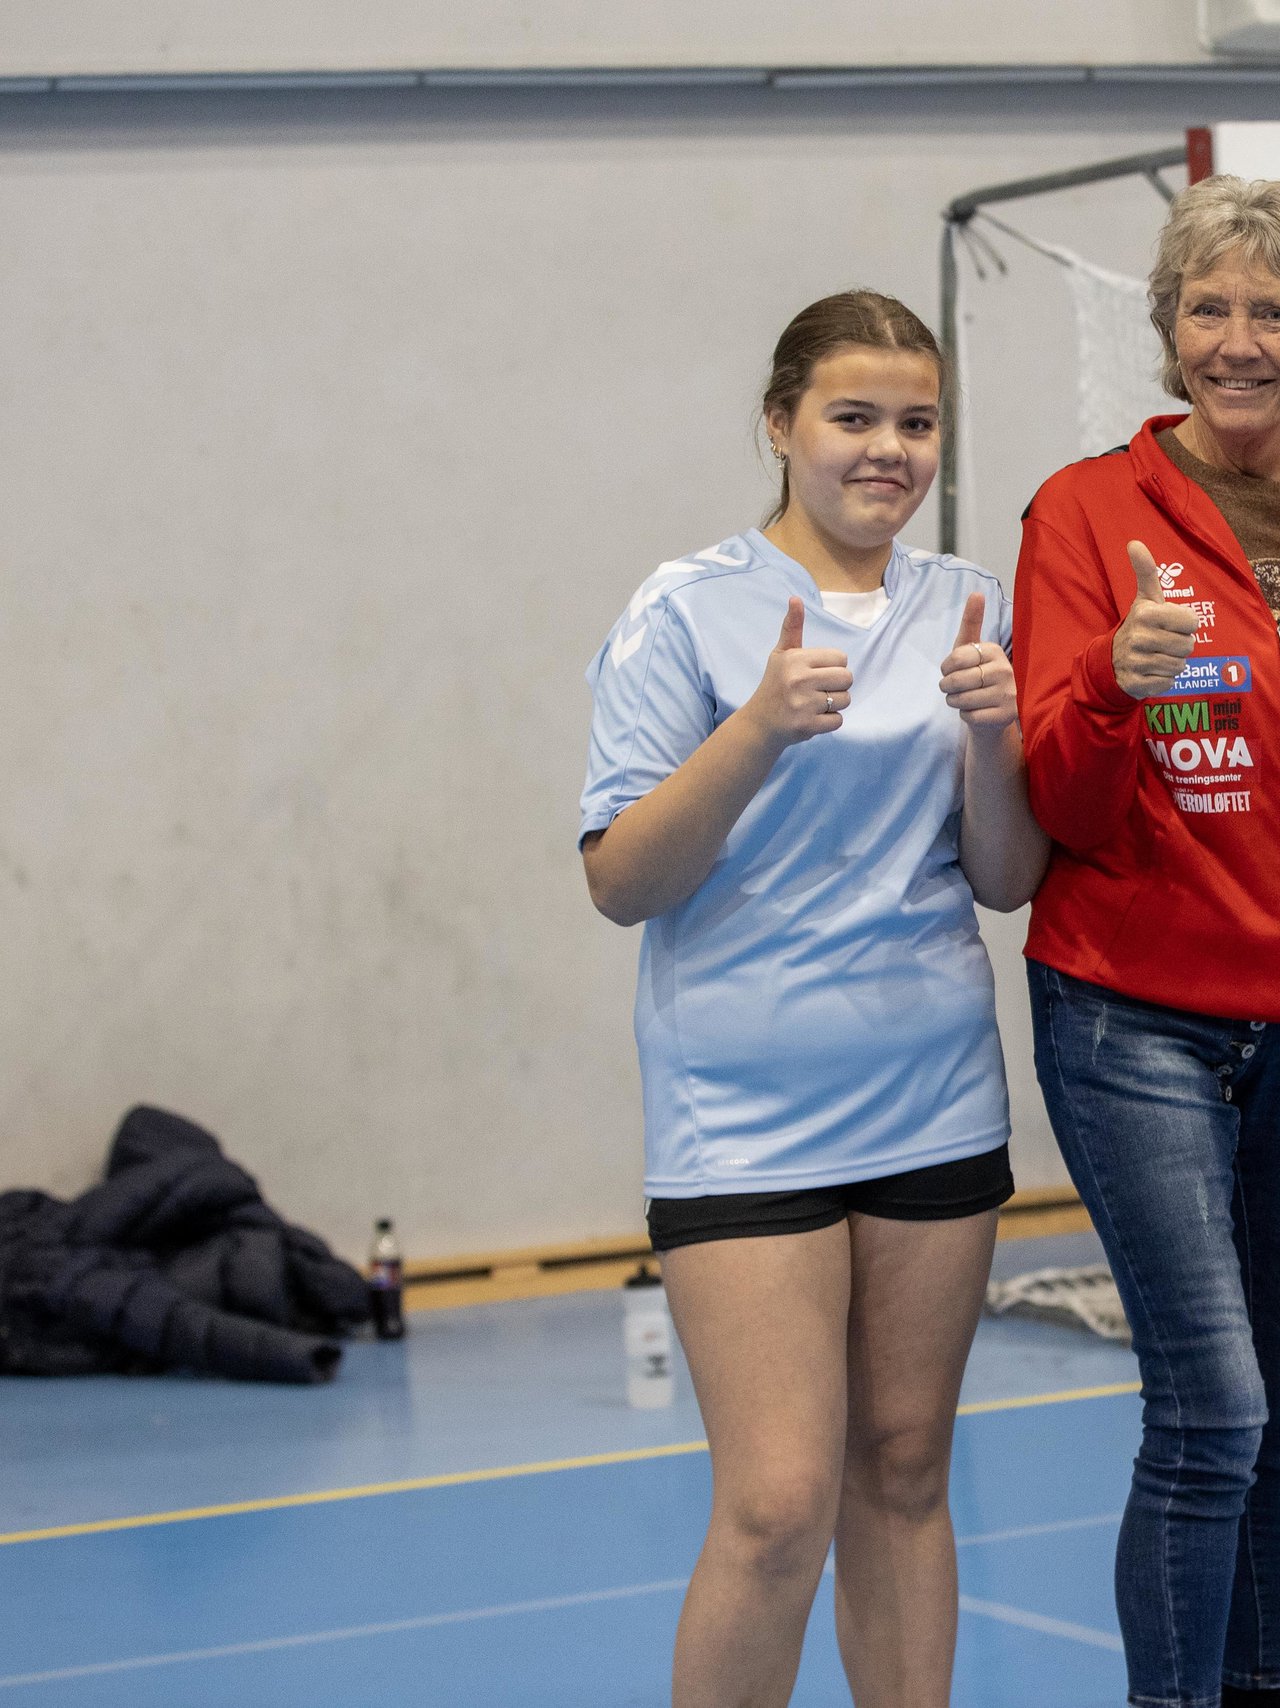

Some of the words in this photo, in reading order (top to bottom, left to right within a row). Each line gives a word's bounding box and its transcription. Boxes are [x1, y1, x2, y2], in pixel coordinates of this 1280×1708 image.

[1163, 586, 1195, 598] mmel
[1175, 662, 1219, 679] Bank
[1228, 665, 1238, 682] 1
[1171, 678, 1220, 690] TLANDET
[1144, 701, 1211, 734] KIWI
[1215, 717, 1239, 734] pris
[1176, 773, 1242, 785] treningssenter
